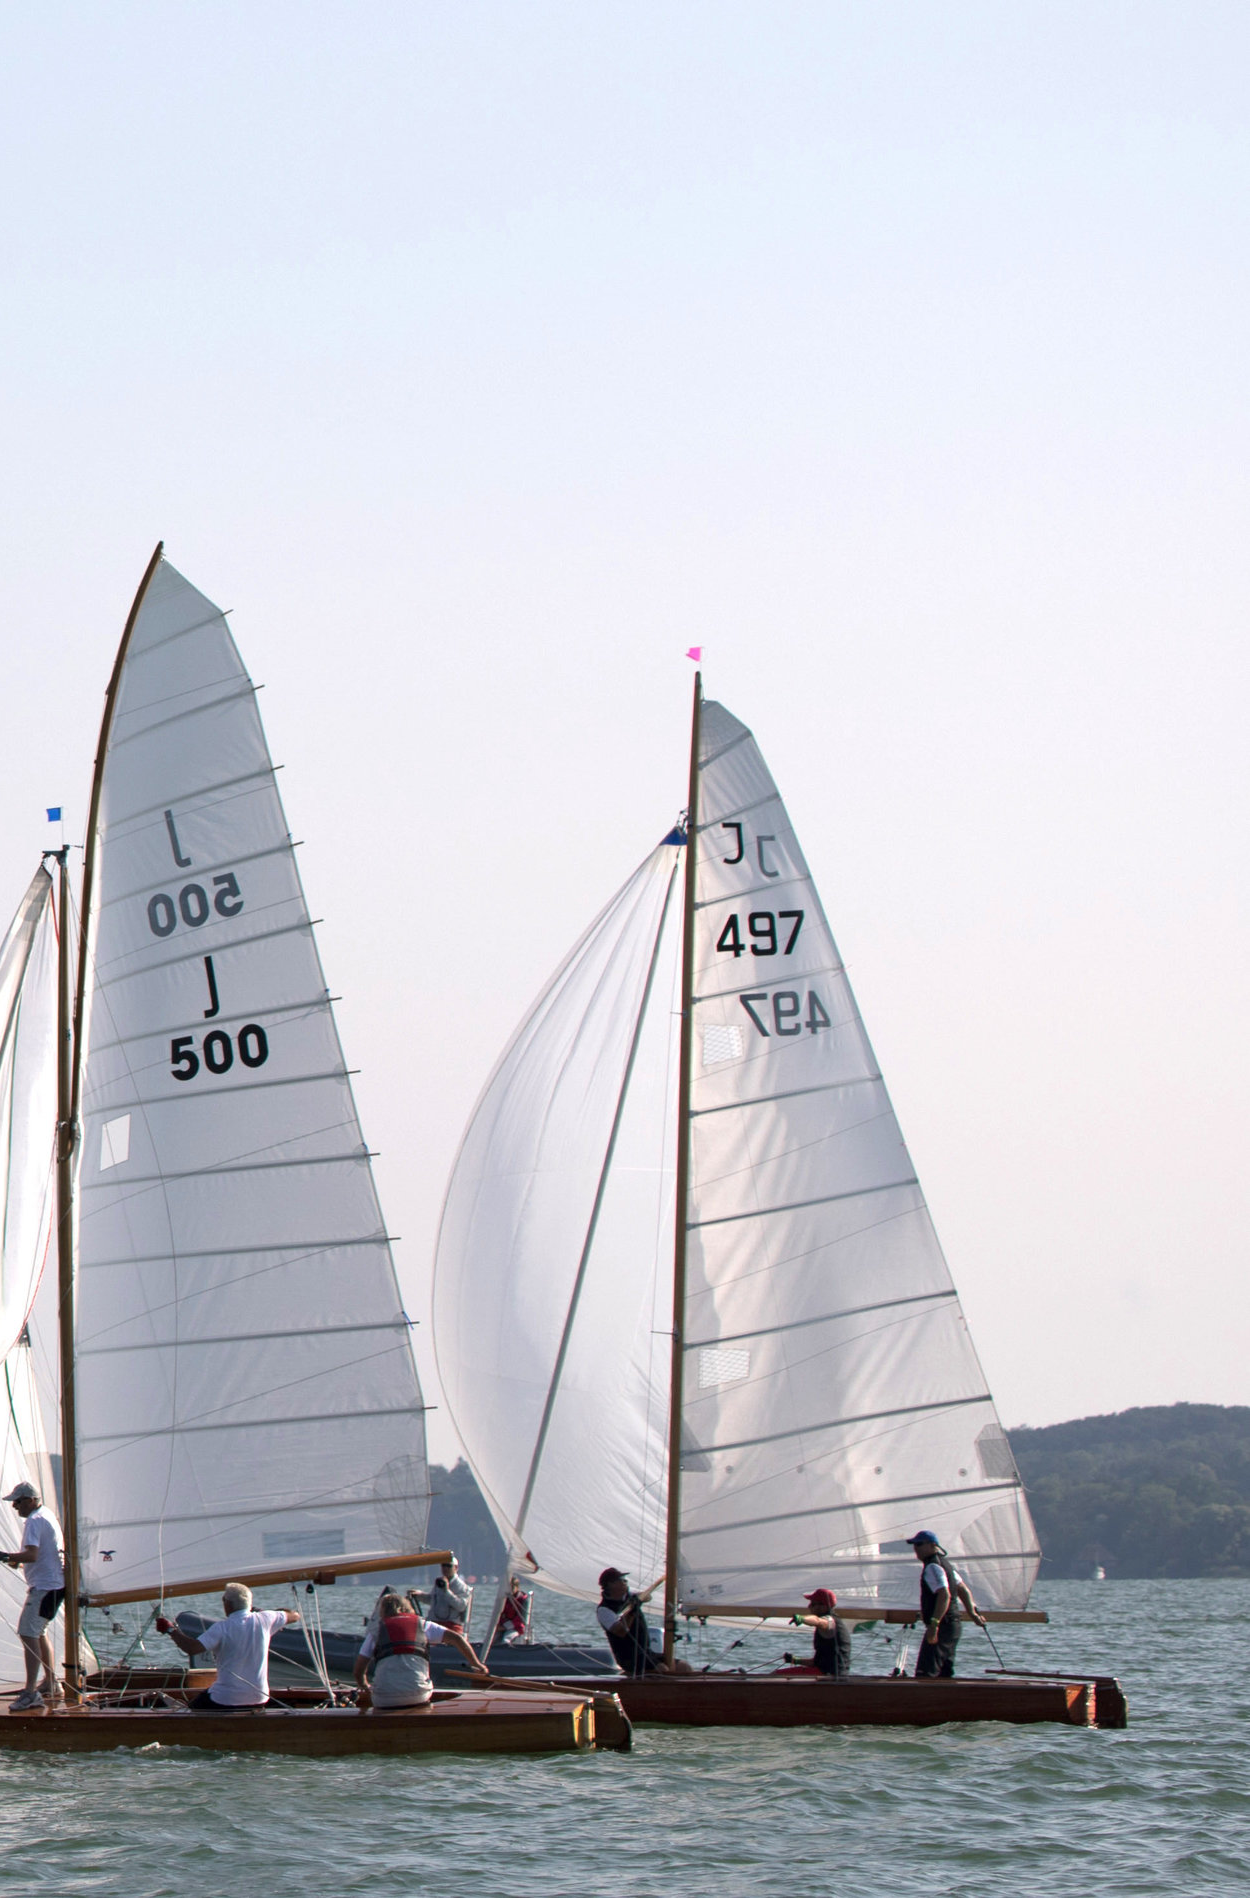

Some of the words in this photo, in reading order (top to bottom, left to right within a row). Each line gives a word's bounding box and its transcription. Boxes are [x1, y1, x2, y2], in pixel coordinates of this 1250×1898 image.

[722, 822, 744, 864] J
[716, 910, 804, 957] 497
[203, 956, 221, 1019] J
[170, 1023, 269, 1081] 500
